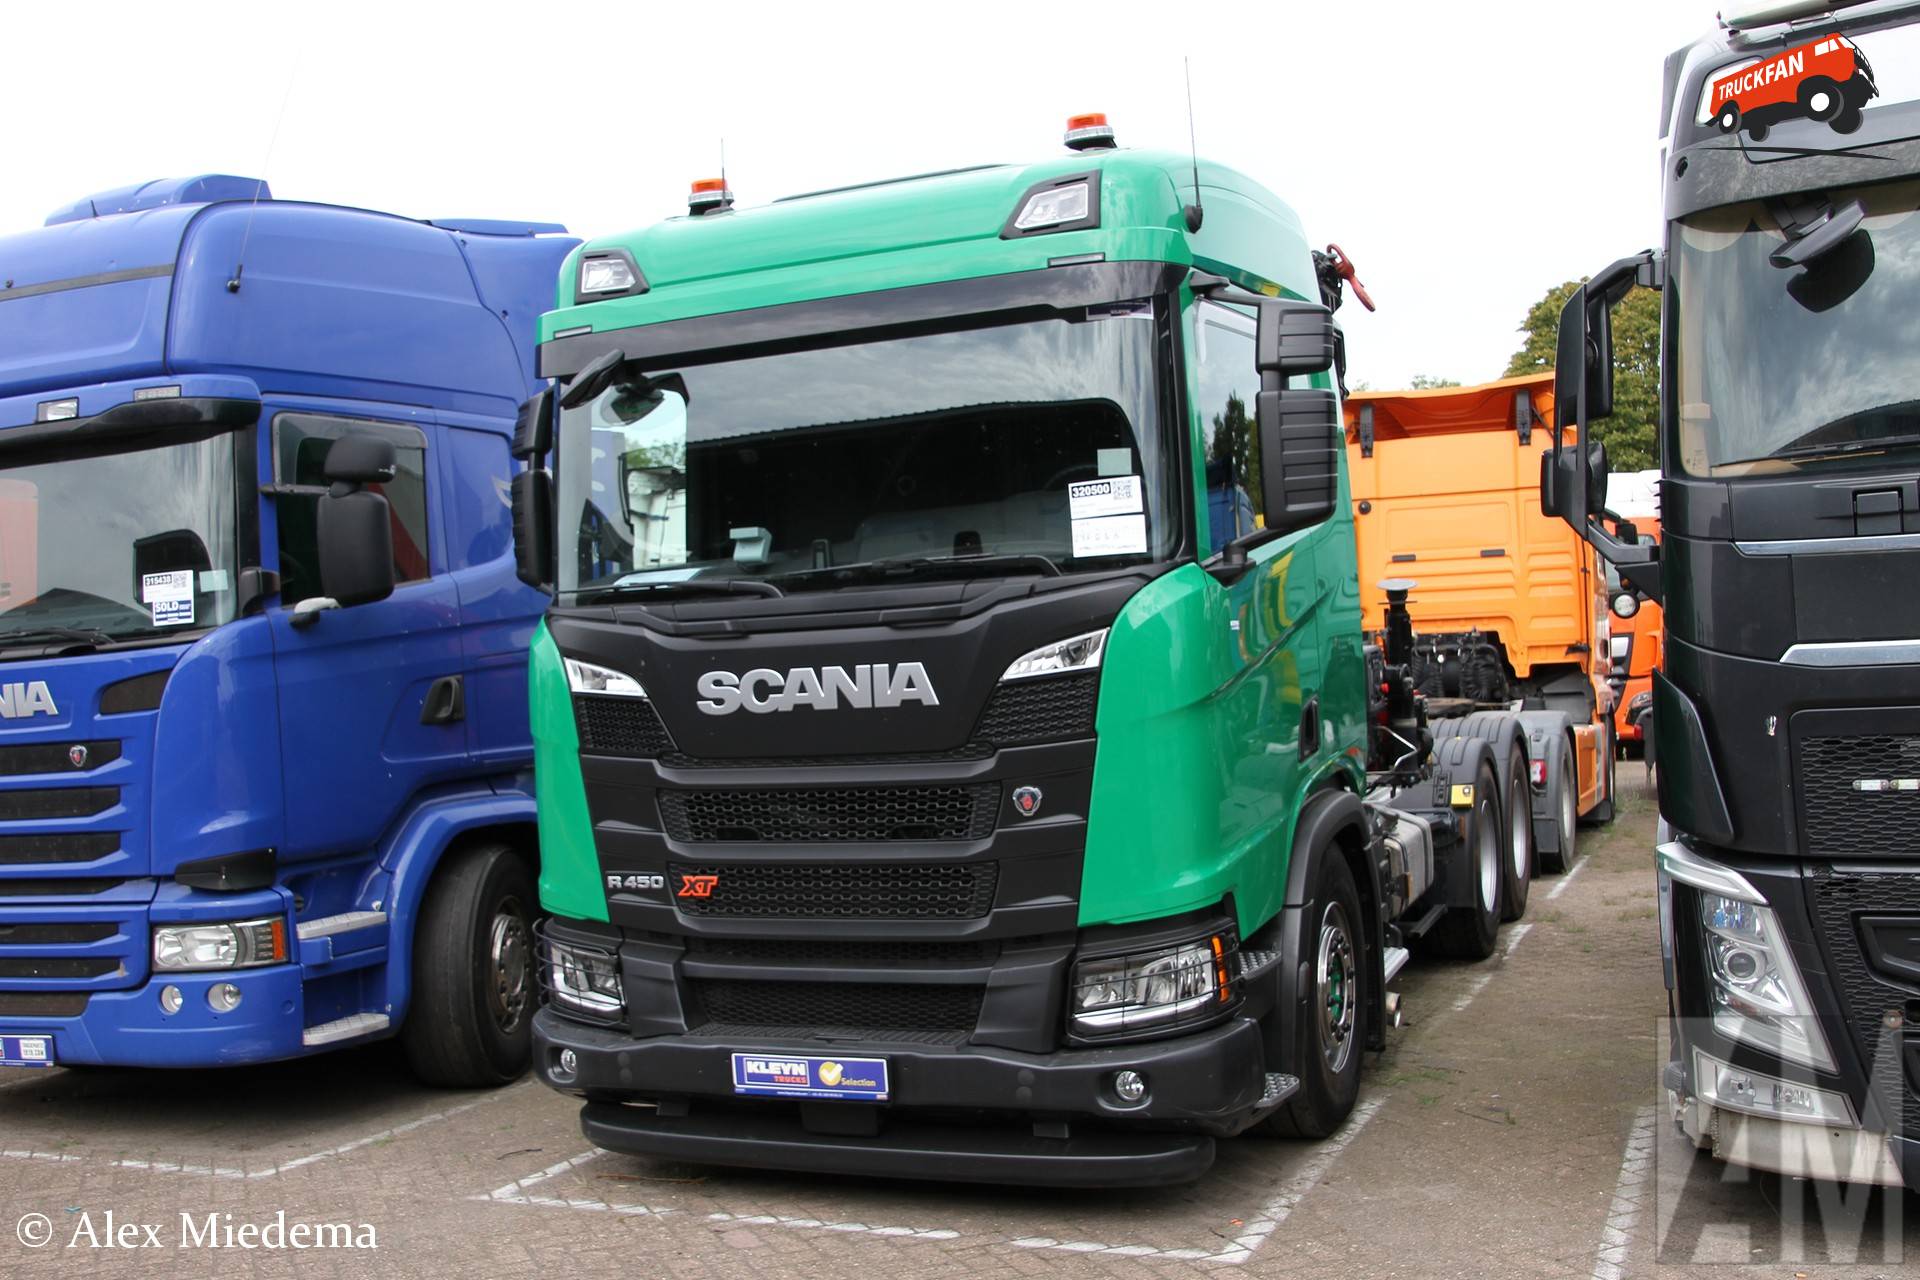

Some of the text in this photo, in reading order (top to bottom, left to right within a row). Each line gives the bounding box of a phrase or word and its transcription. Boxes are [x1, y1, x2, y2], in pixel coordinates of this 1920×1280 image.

[1072, 484, 1110, 498] 320500
[155, 601, 179, 612] SOLD
[697, 661, 940, 716] SCANIA
[677, 875, 719, 897] XT
[746, 1061, 806, 1076] KLEYN
[774, 1075, 808, 1084] TRUCKS
[841, 1077, 876, 1087] Selection
